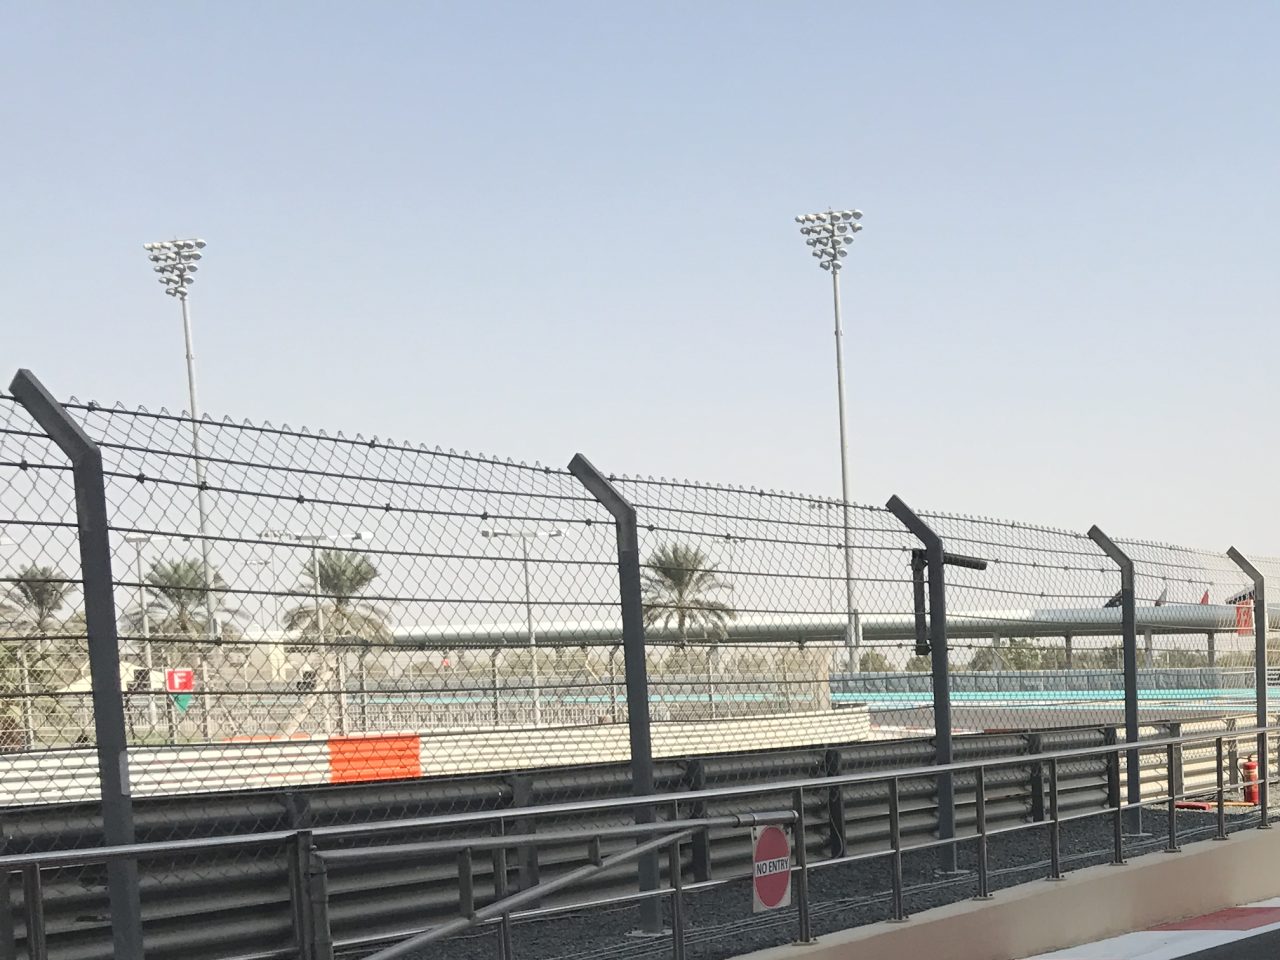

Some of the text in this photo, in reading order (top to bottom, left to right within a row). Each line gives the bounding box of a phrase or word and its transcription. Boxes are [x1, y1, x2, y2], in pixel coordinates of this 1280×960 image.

[173, 672, 186, 689] F
[757, 859, 788, 875] NO ENTRY
